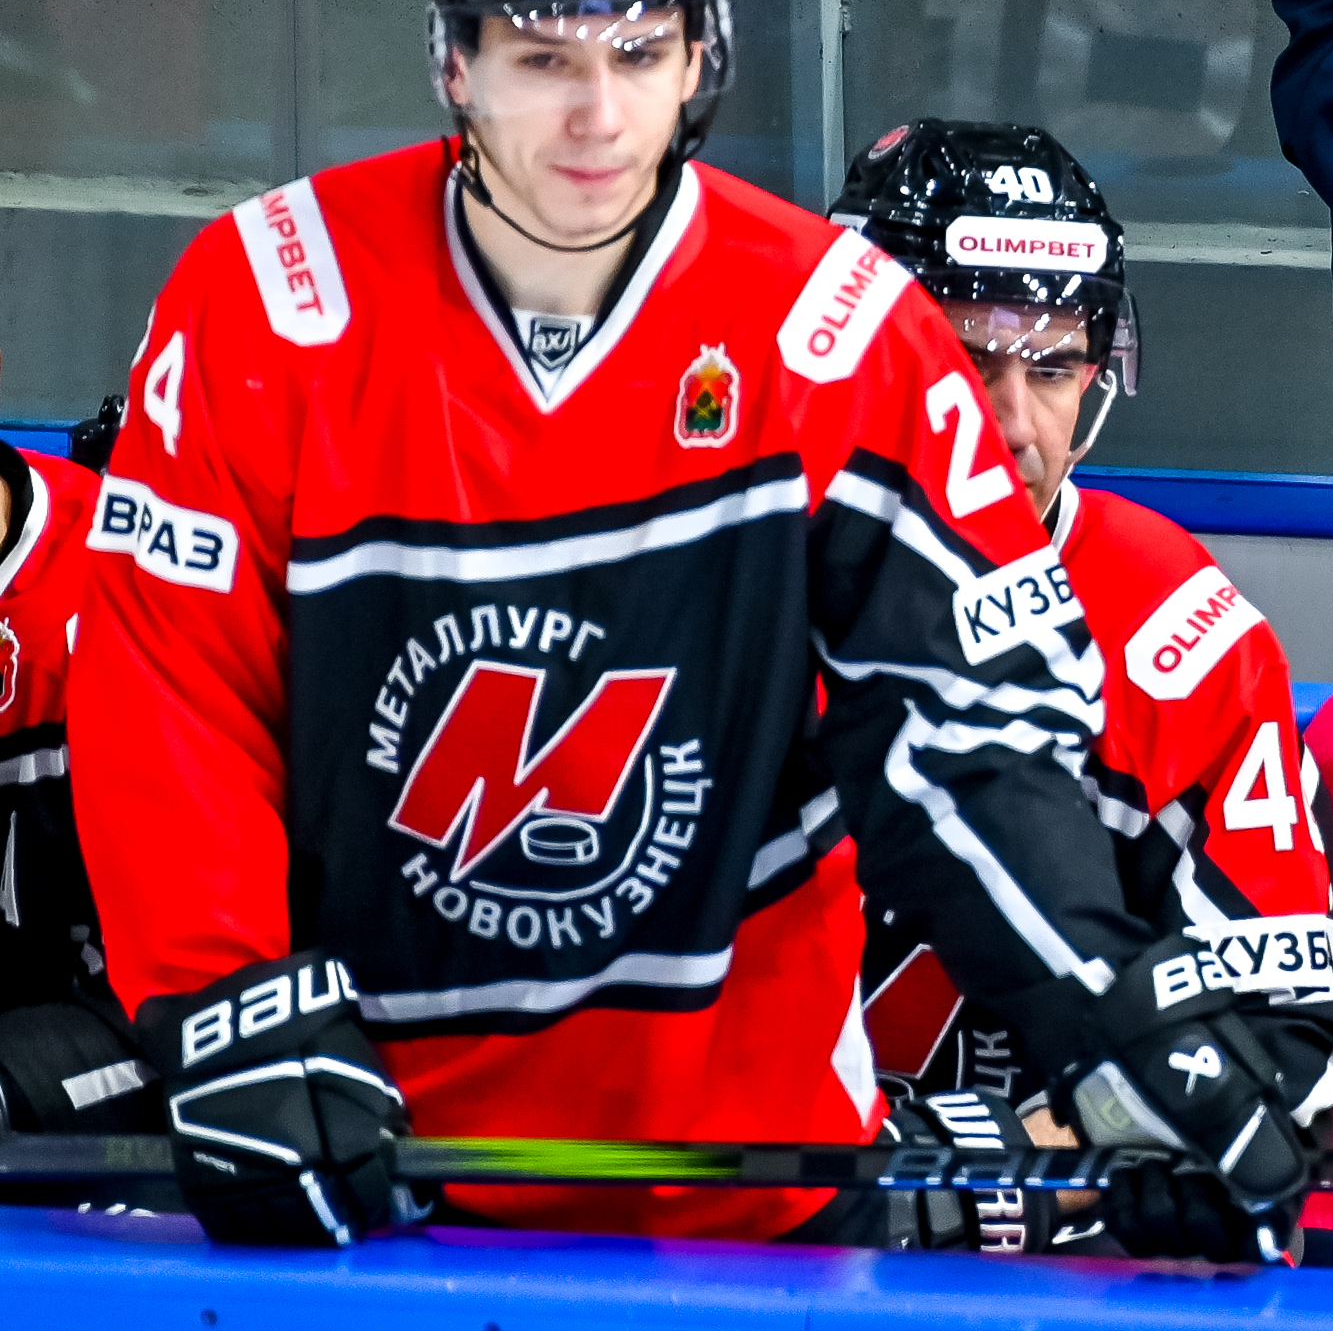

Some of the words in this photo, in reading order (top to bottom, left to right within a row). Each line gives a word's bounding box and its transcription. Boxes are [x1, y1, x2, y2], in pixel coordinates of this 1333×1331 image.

[985, 164, 1054, 203] 40
[807, 244, 894, 358] OLIMP
[958, 235, 1096, 259] OLIMPBET
[128, 323, 187, 458] 4
[365, 603, 606, 774] МЕТАЛЛУРГ
[401, 738, 714, 949] НОВОКУЗНЕЦК
